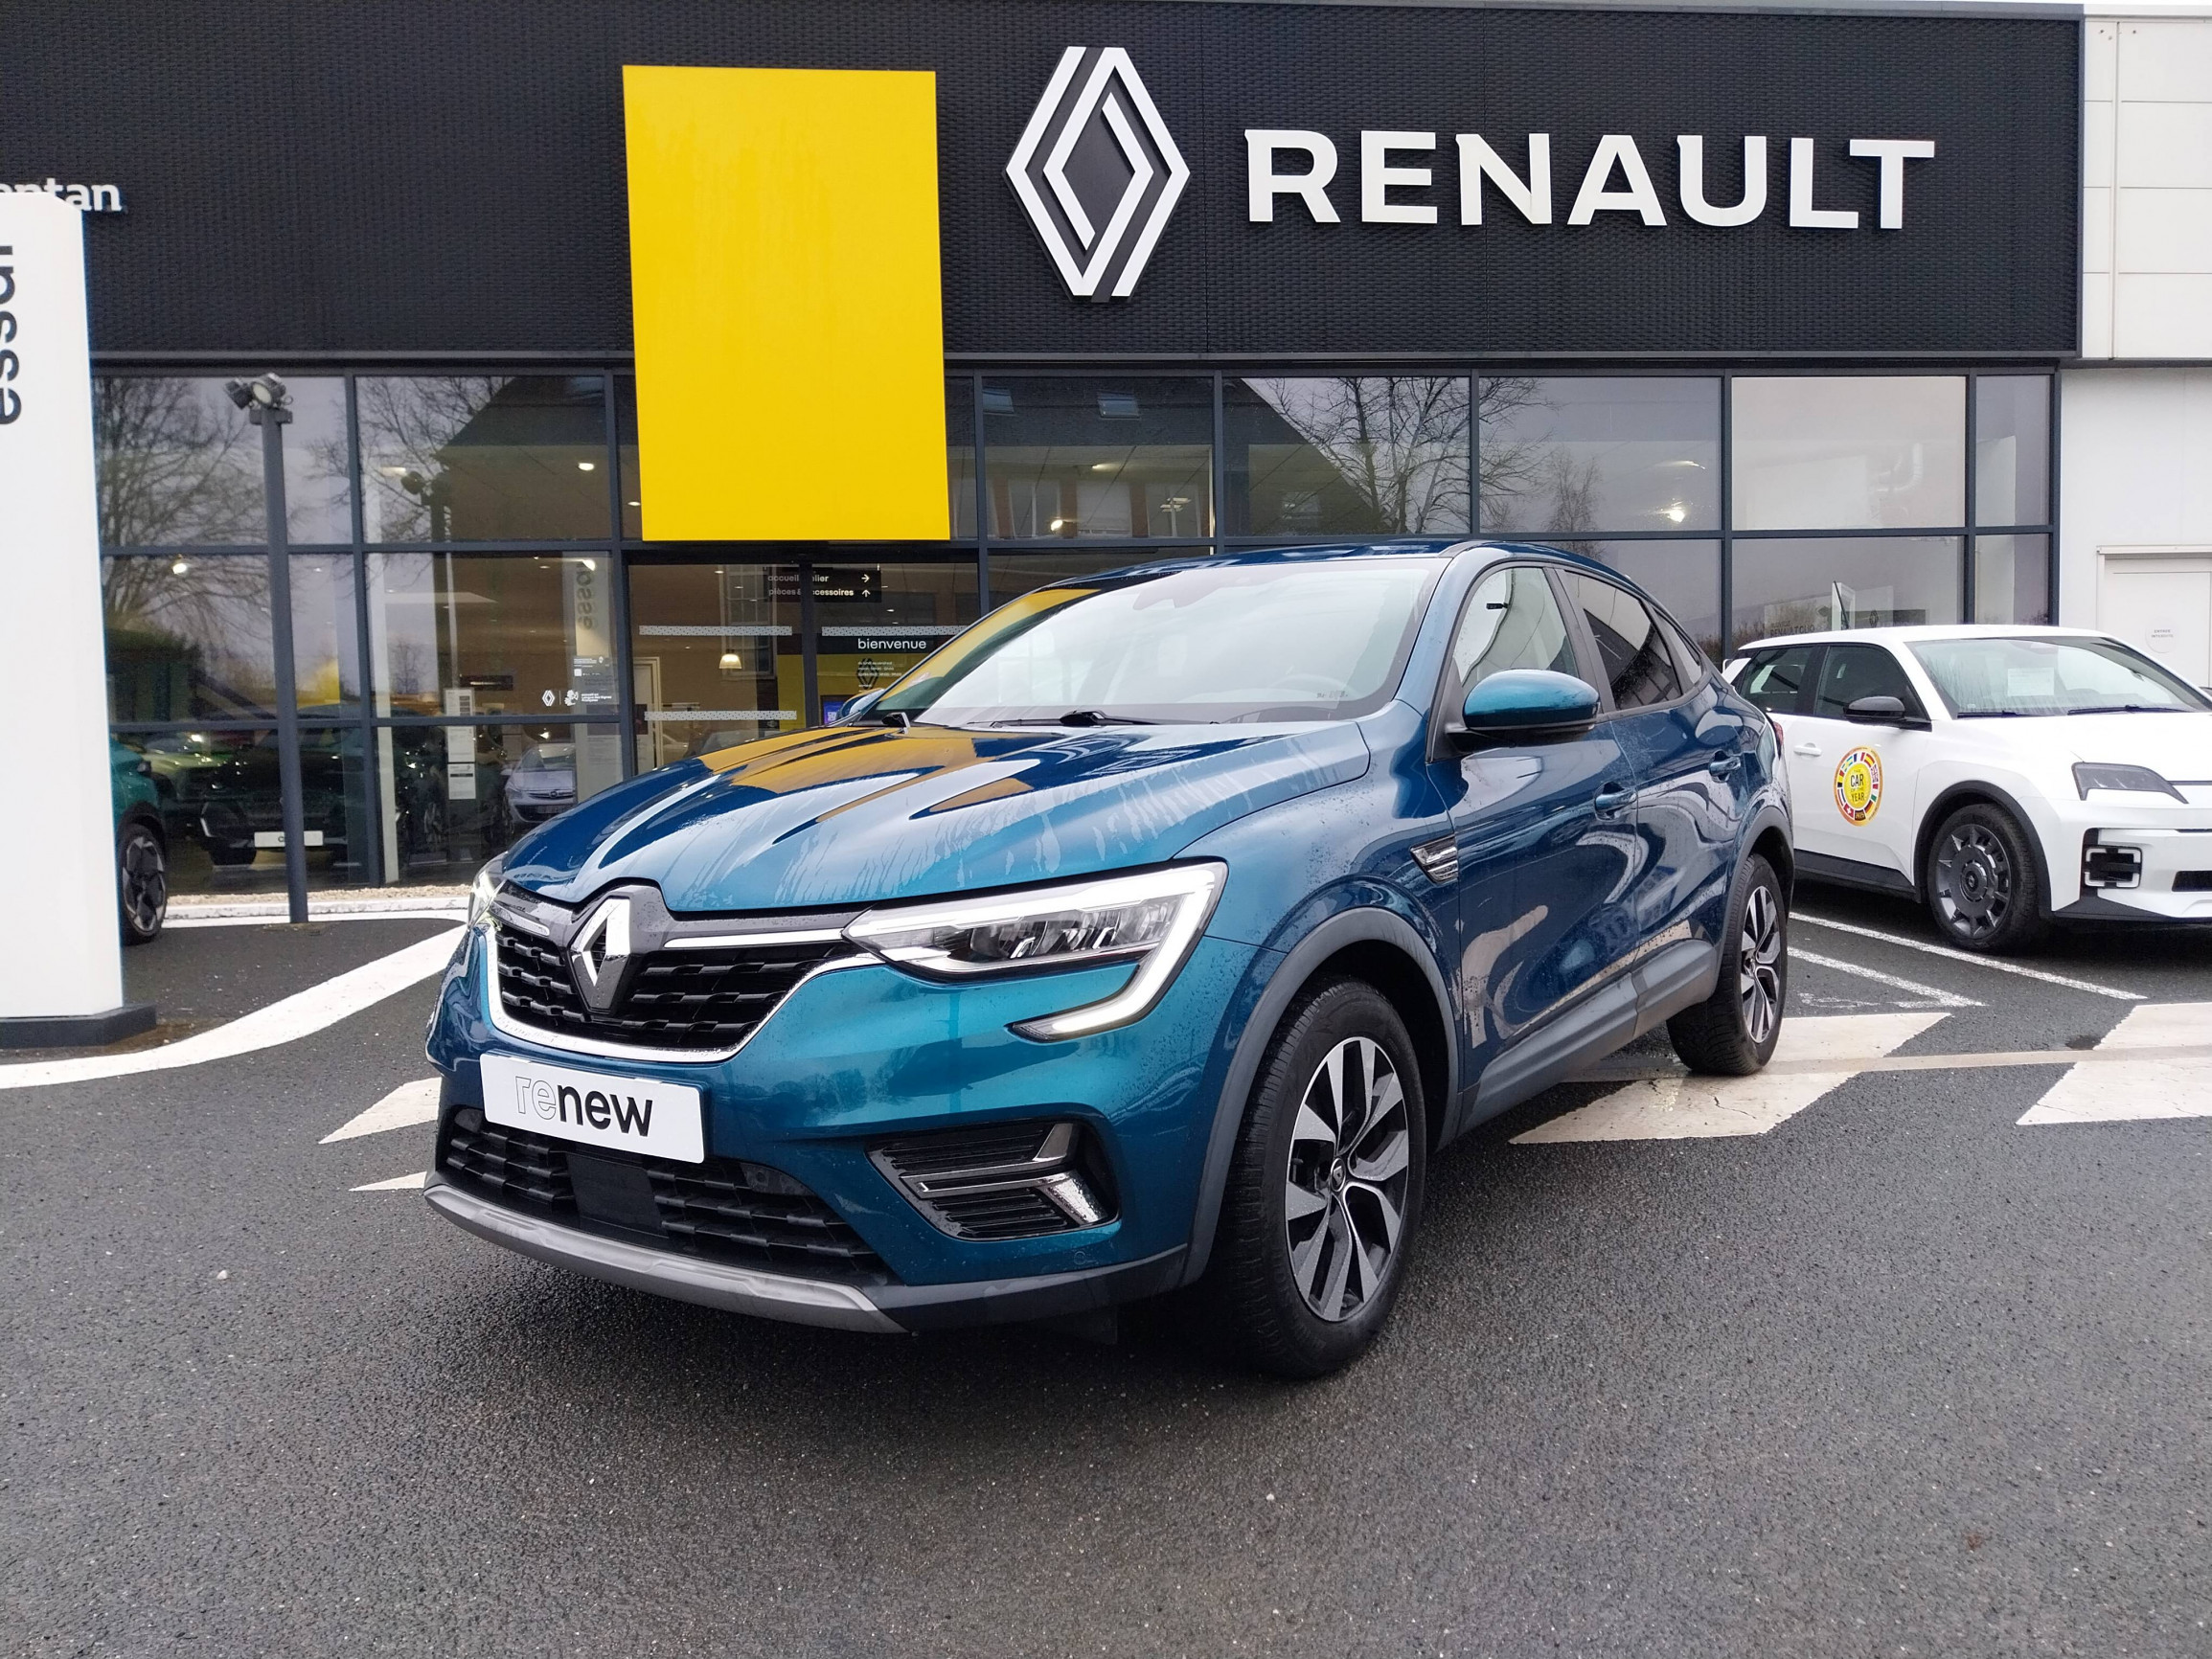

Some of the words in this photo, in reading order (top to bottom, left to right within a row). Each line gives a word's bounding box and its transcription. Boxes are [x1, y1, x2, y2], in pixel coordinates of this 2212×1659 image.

[1244, 128, 1935, 230] RENAULT
[767, 574, 799, 582] accueil
[768, 587, 796, 596] pièces
[857, 638, 926, 649] bienvenue
[1850, 774, 1864, 787] CAR
[1850, 792, 1865, 803] YEAR
[514, 1076, 653, 1137] renew
